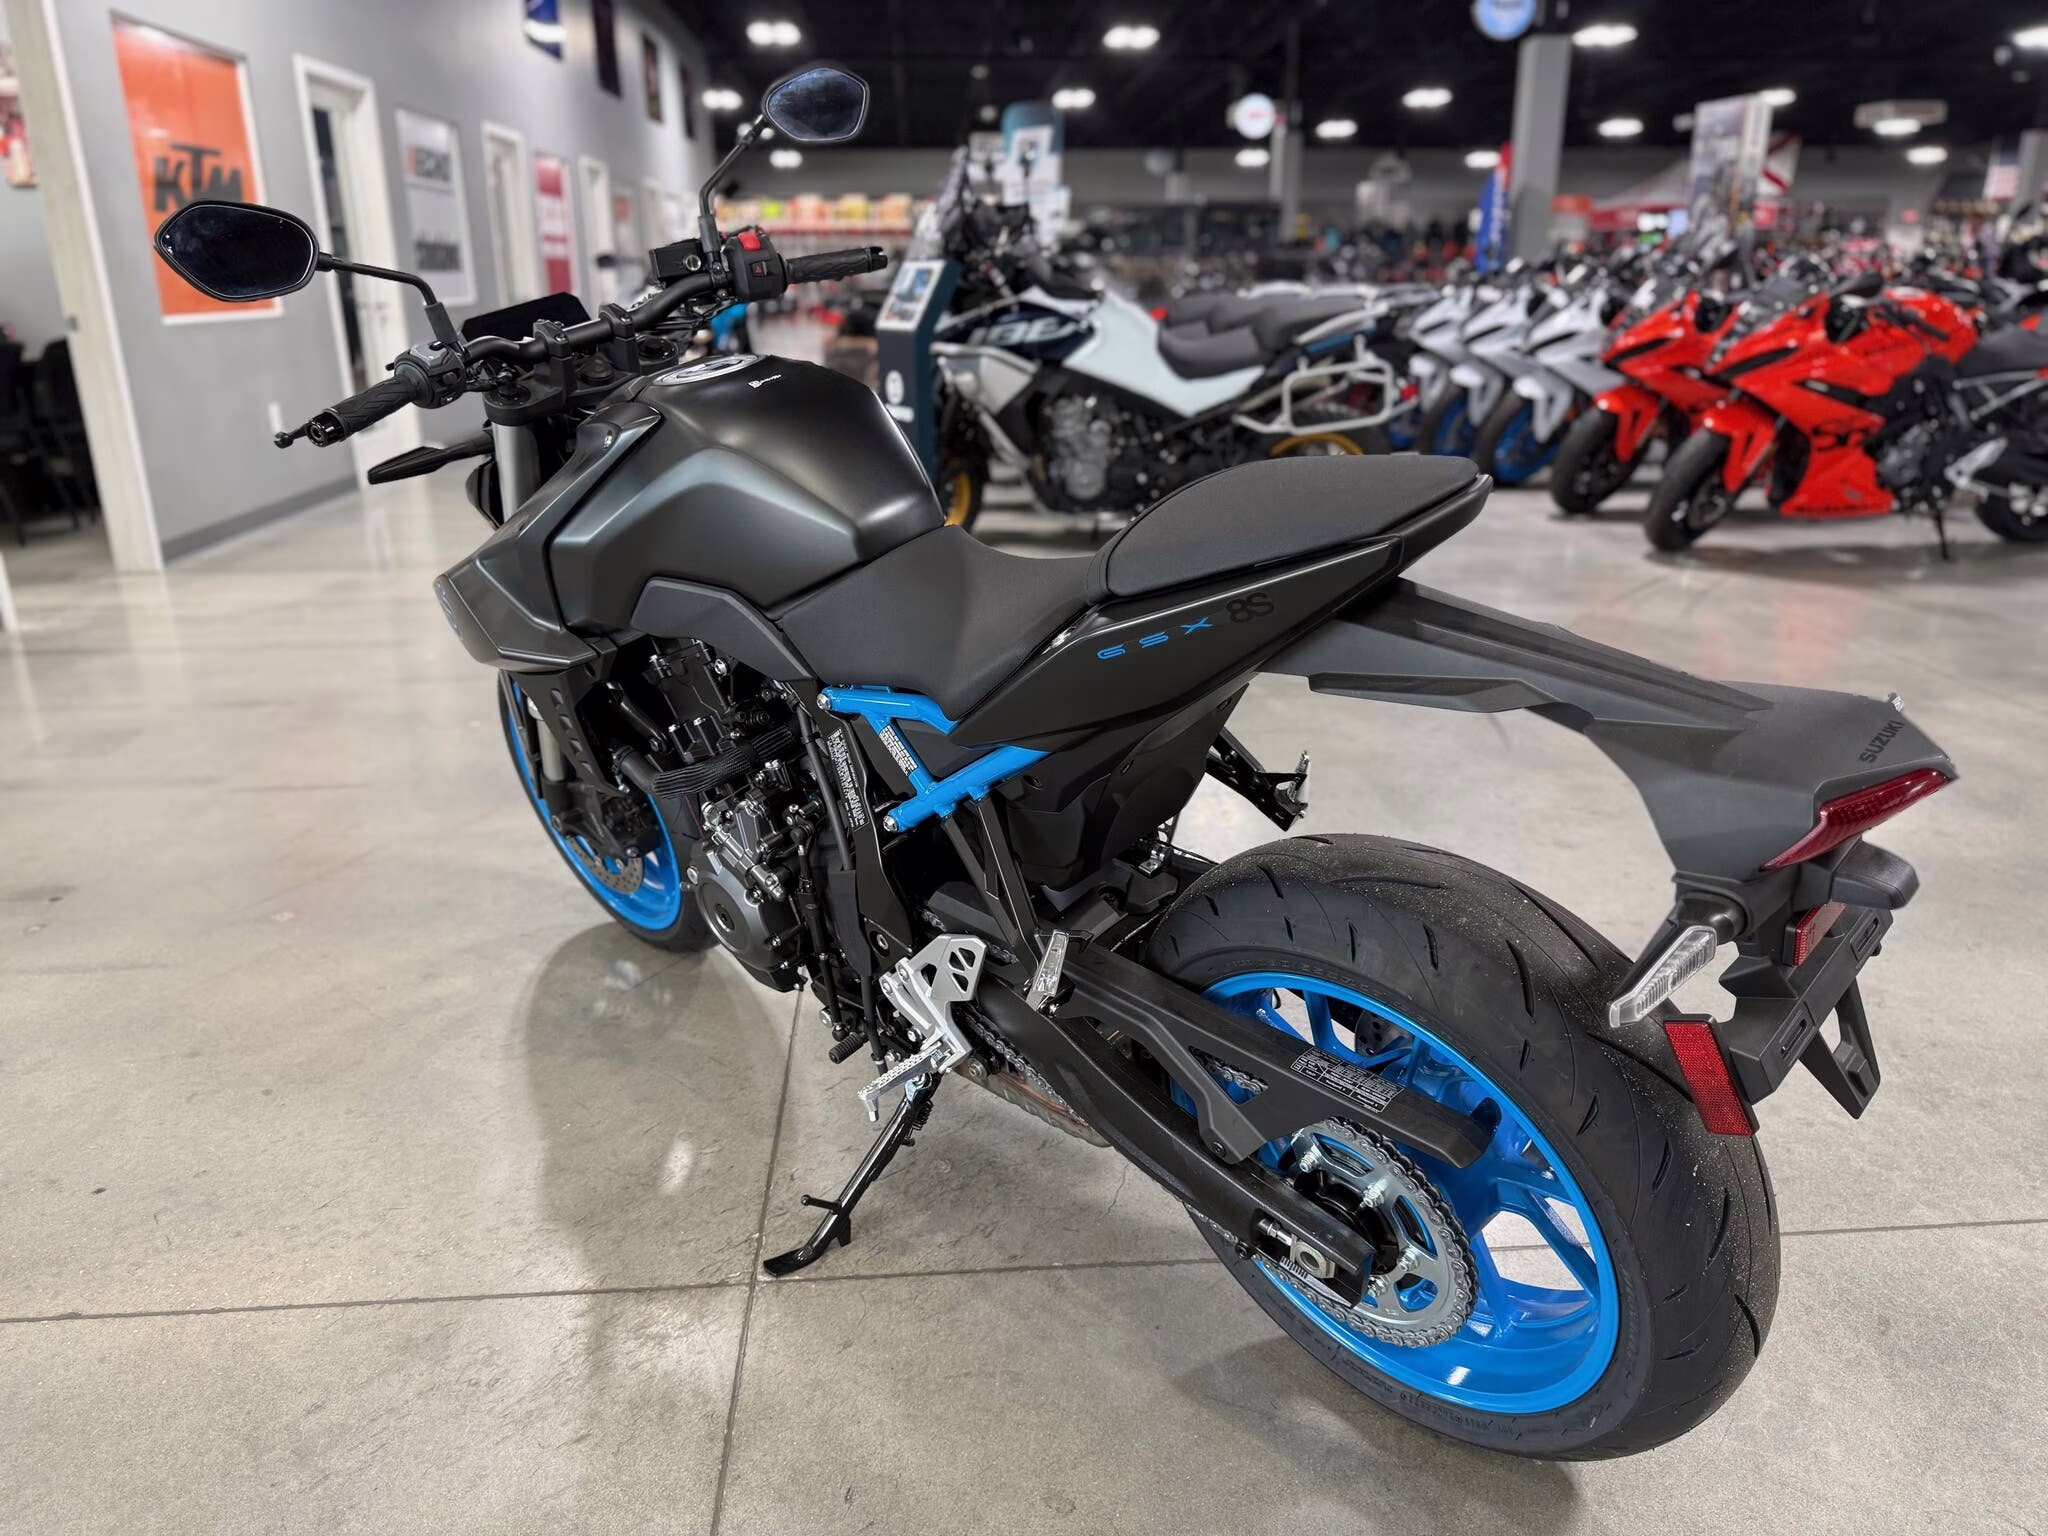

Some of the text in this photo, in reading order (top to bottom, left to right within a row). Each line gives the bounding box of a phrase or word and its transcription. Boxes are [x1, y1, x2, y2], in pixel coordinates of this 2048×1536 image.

[153, 142, 243, 212] KTM
[1097, 592, 1275, 660] GSX 8S
[1859, 720, 1906, 764] SUZUKI
